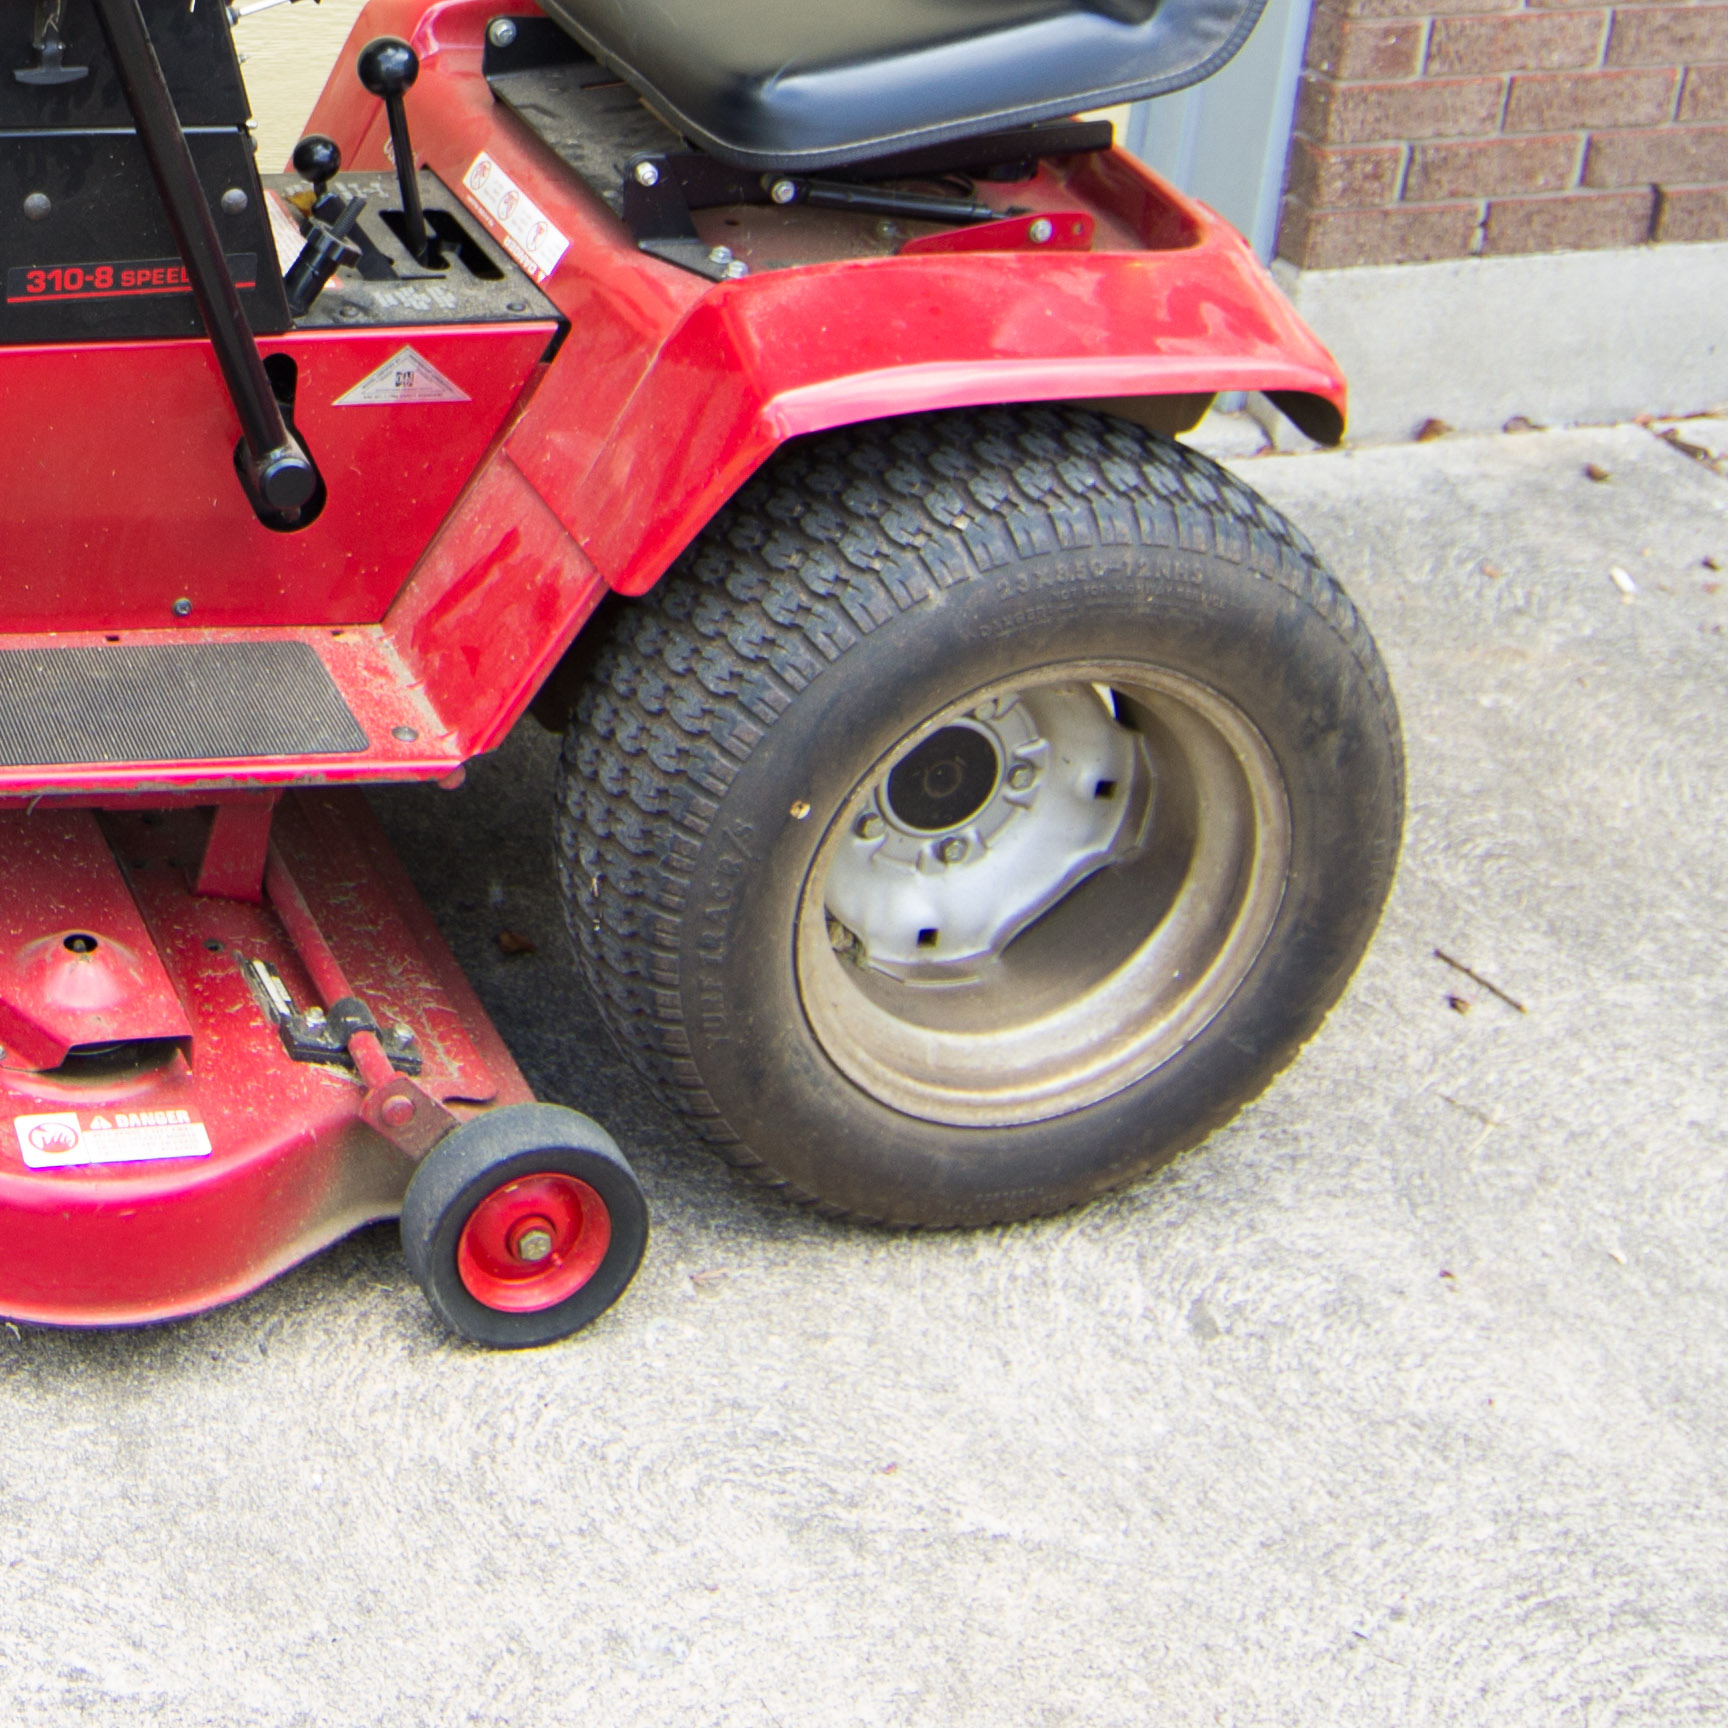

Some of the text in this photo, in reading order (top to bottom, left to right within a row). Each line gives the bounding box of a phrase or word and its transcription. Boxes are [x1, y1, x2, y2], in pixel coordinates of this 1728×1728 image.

[26, 265, 191, 293] 310-8 SPEE
[115, 1109, 191, 1129] DANGER
